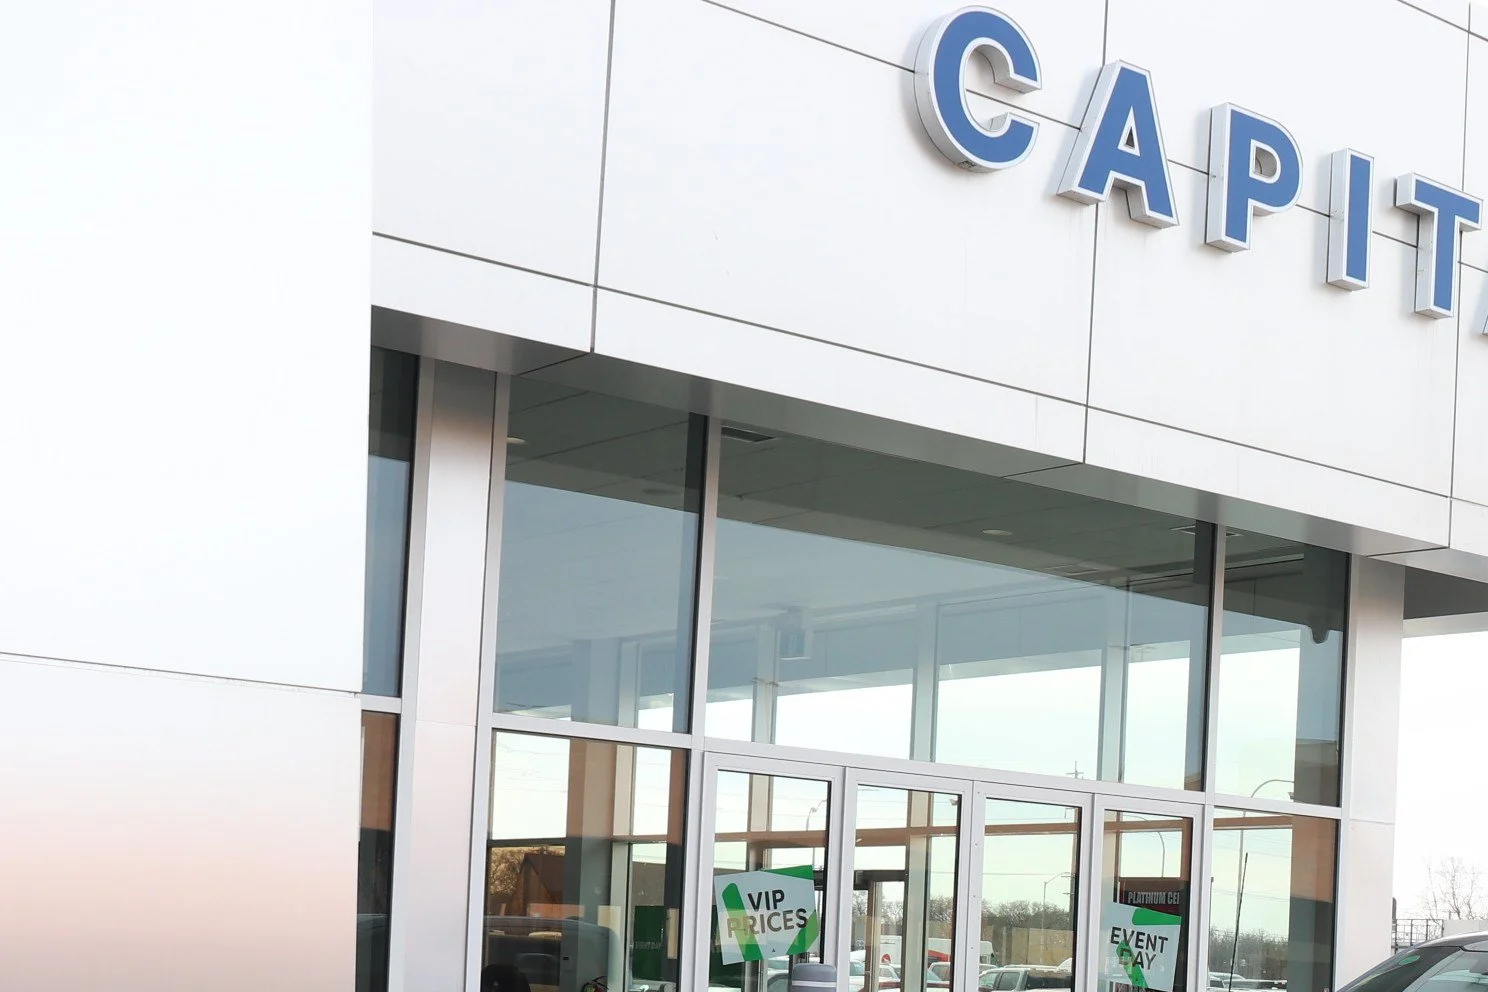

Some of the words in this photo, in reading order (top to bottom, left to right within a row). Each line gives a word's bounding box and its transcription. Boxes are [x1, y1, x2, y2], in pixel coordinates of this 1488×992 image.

[747, 889, 785, 912] VIP
[1127, 891, 1166, 904] PLATINUM
[726, 908, 809, 939] PRICES
[1110, 926, 1169, 953] EVENT
[1119, 947, 1157, 970] DAY
